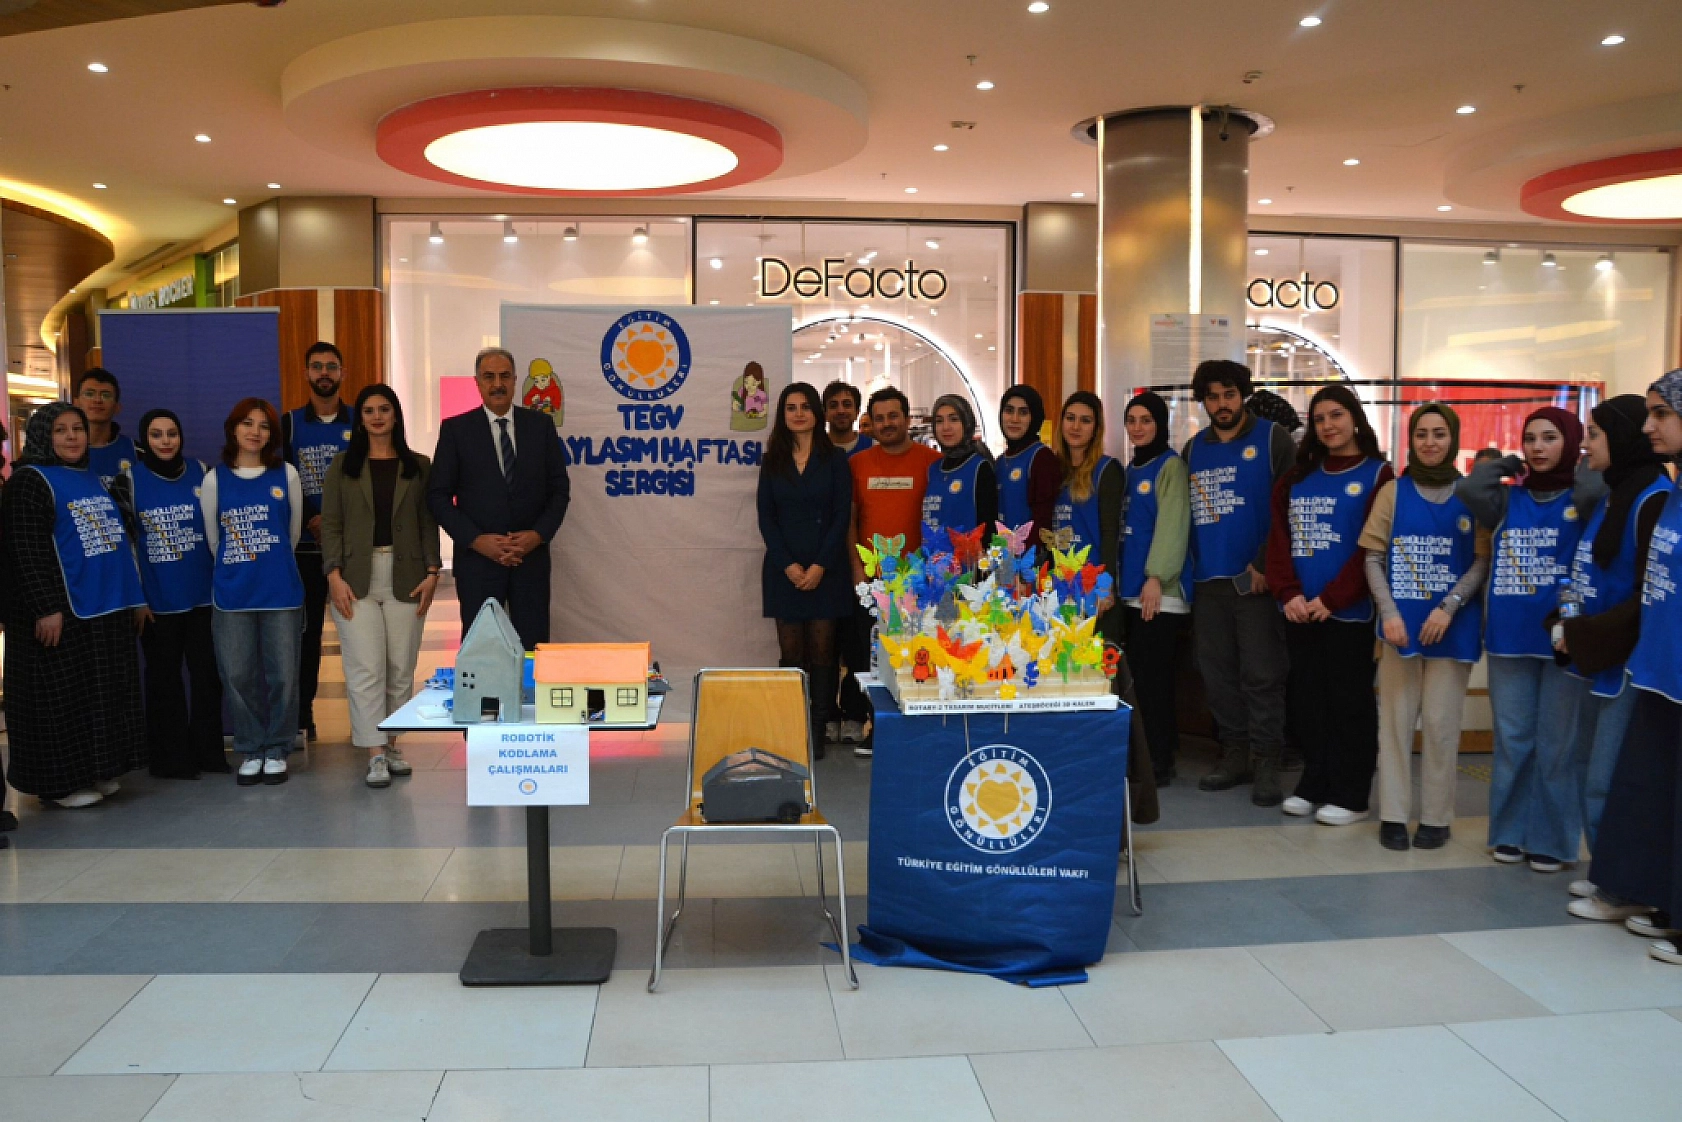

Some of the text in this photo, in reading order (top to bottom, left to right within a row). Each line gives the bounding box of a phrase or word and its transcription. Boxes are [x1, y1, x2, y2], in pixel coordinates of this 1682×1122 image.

[762, 258, 947, 299] DeFacto
[617, 404, 684, 431] TEGV
[661, 436, 762, 466] HAFTASI
[605, 461, 695, 497] SERGİSİ
[501, 731, 555, 742] ROBOTİK
[498, 749, 558, 758] KODLAMA
[488, 765, 569, 776] ÇALIŞMALARI
[897, 857, 1089, 879] TÜRKİYE EĞİTİM GÖNÜLLÜLERİ VAKFI
